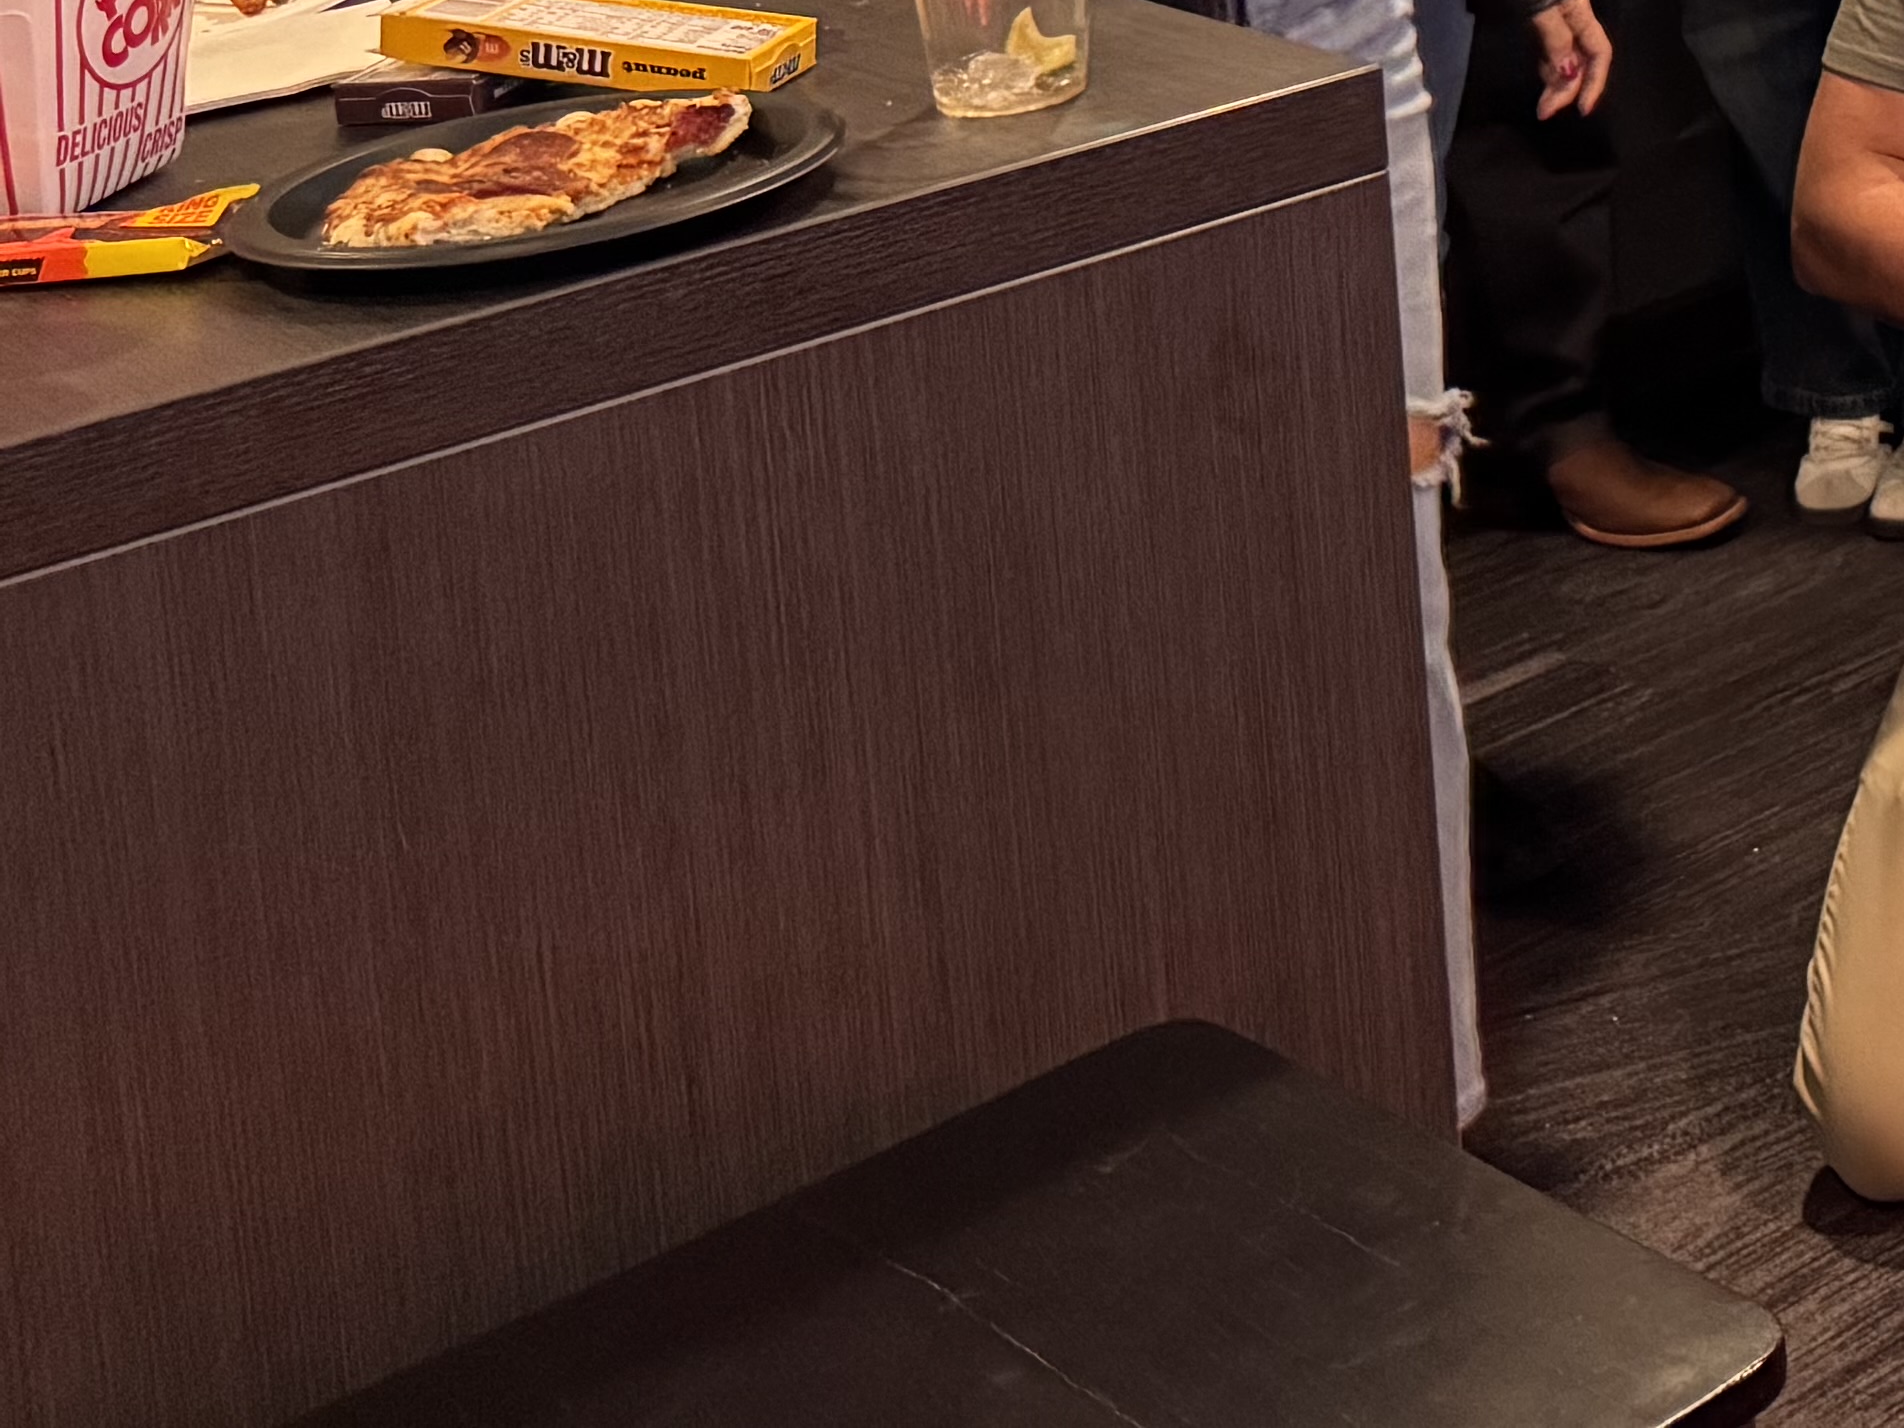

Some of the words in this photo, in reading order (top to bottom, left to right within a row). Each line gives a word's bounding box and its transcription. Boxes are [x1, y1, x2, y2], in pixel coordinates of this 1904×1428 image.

[621, 61, 706, 81] peanut
[56, 102, 144, 168] DELICIOUS
[141, 115, 183, 164] CRISP
